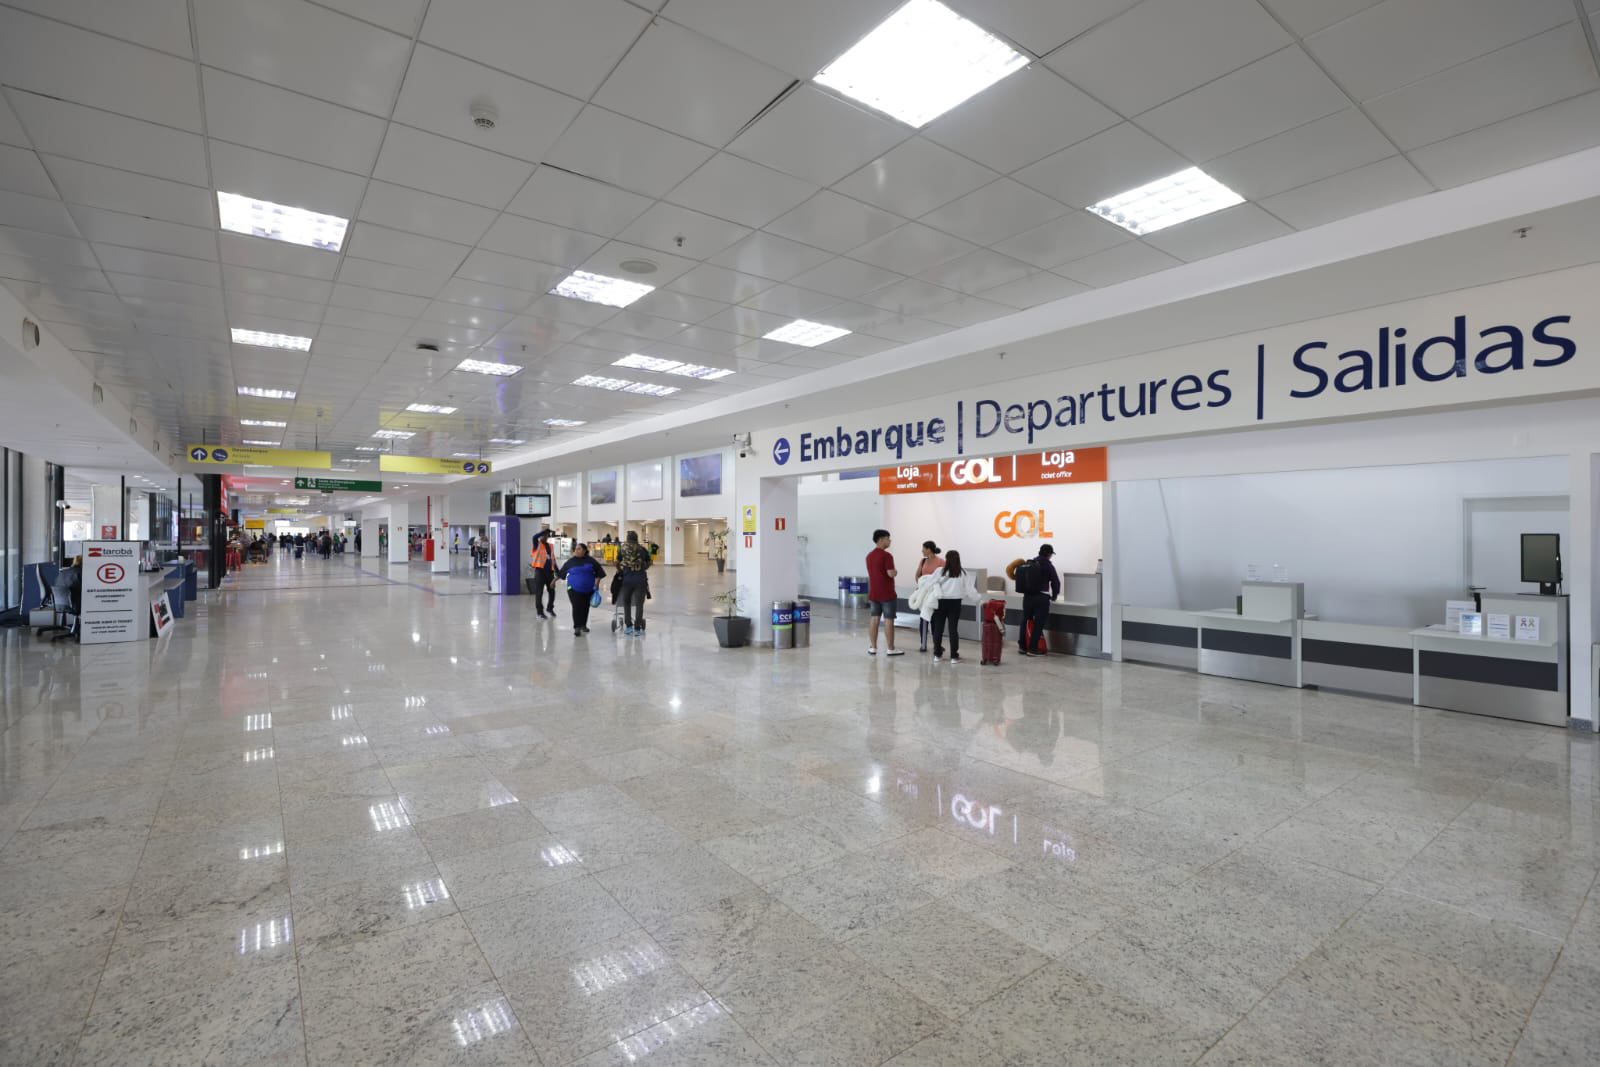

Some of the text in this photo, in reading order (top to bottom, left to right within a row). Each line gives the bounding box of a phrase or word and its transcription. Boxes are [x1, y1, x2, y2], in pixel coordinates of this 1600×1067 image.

[800, 315, 1577, 459] Embarque Departures Salidas
[897, 450, 1075, 485] Loja GOL Loja
[994, 509, 1053, 538] GOL
[105, 567, 116, 579] E
